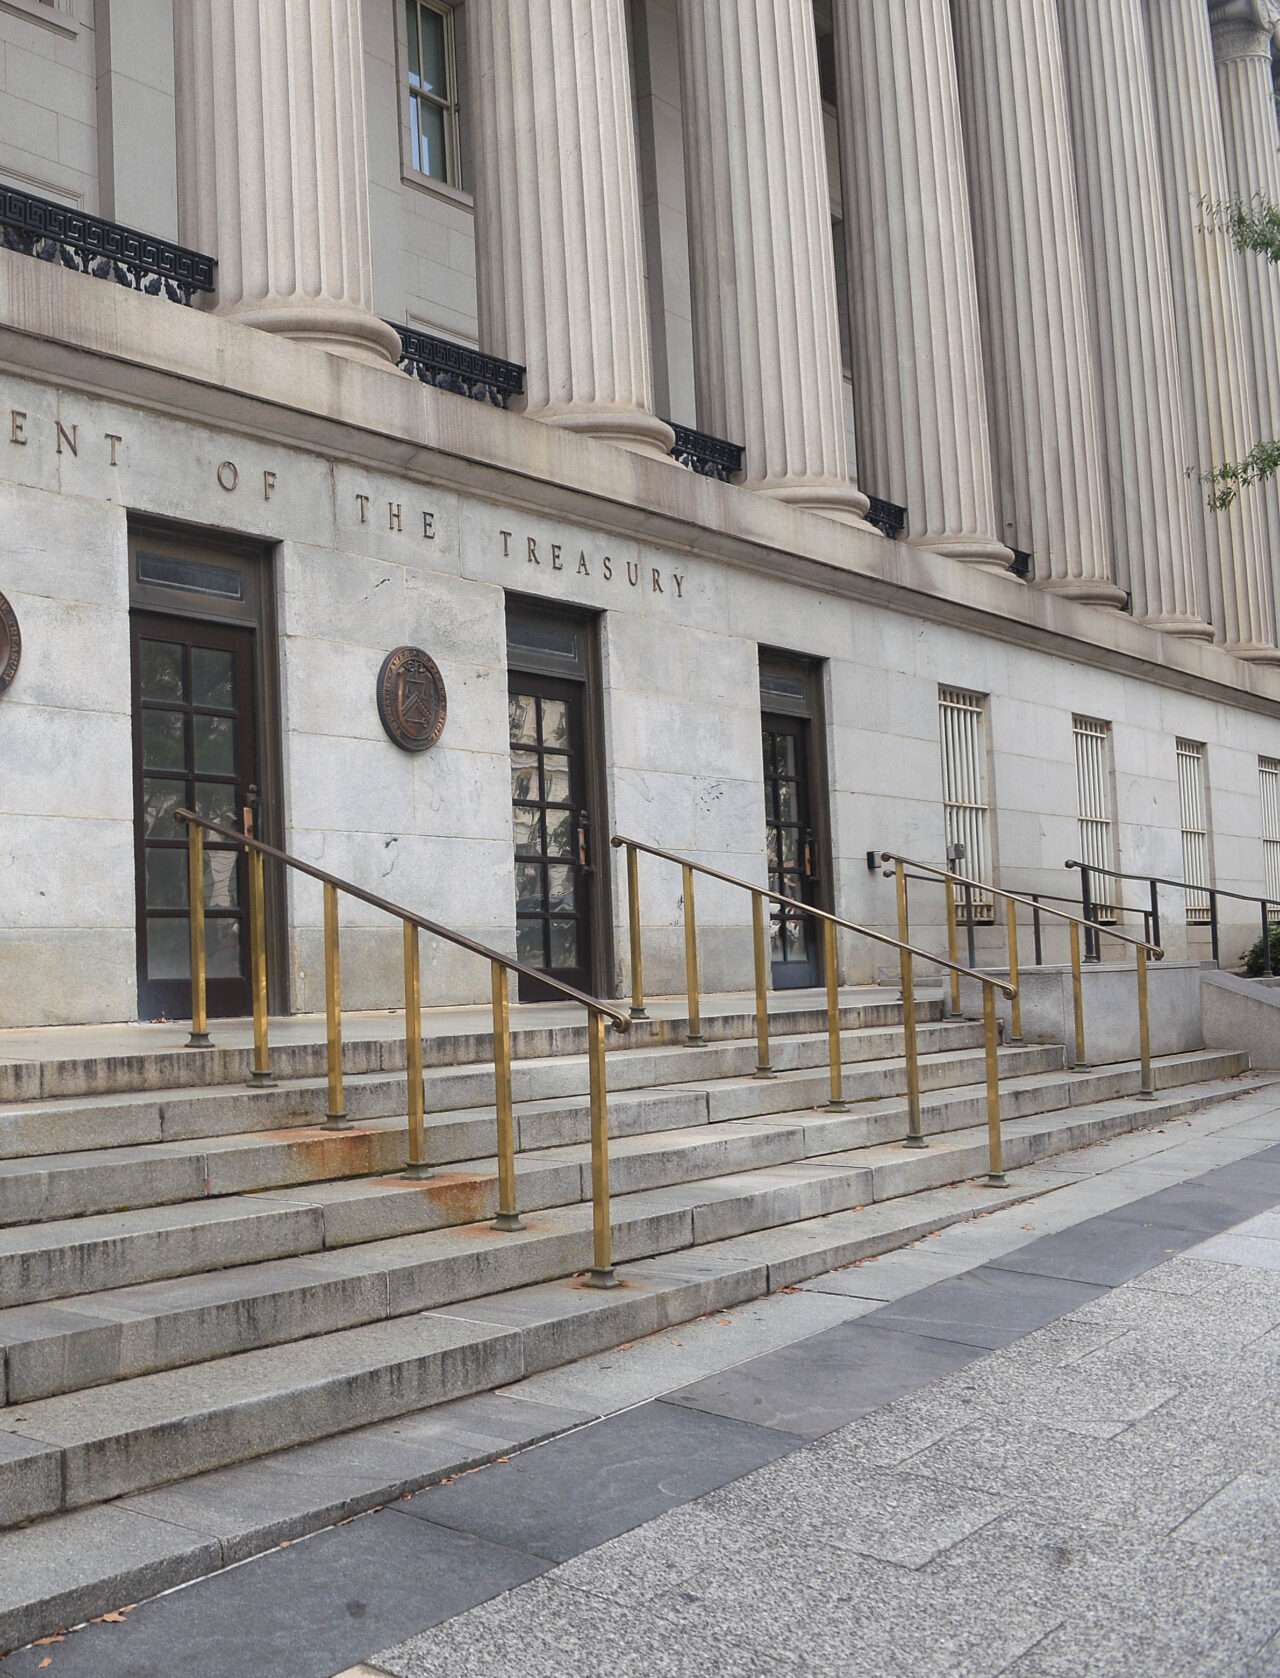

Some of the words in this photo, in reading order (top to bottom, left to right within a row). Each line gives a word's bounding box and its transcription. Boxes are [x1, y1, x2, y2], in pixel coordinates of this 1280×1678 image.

[217, 461, 277, 500] OF
[356, 495, 435, 539] THE
[500, 530, 686, 598] TREASURY
[2, 618, 20, 683] TREASURY
